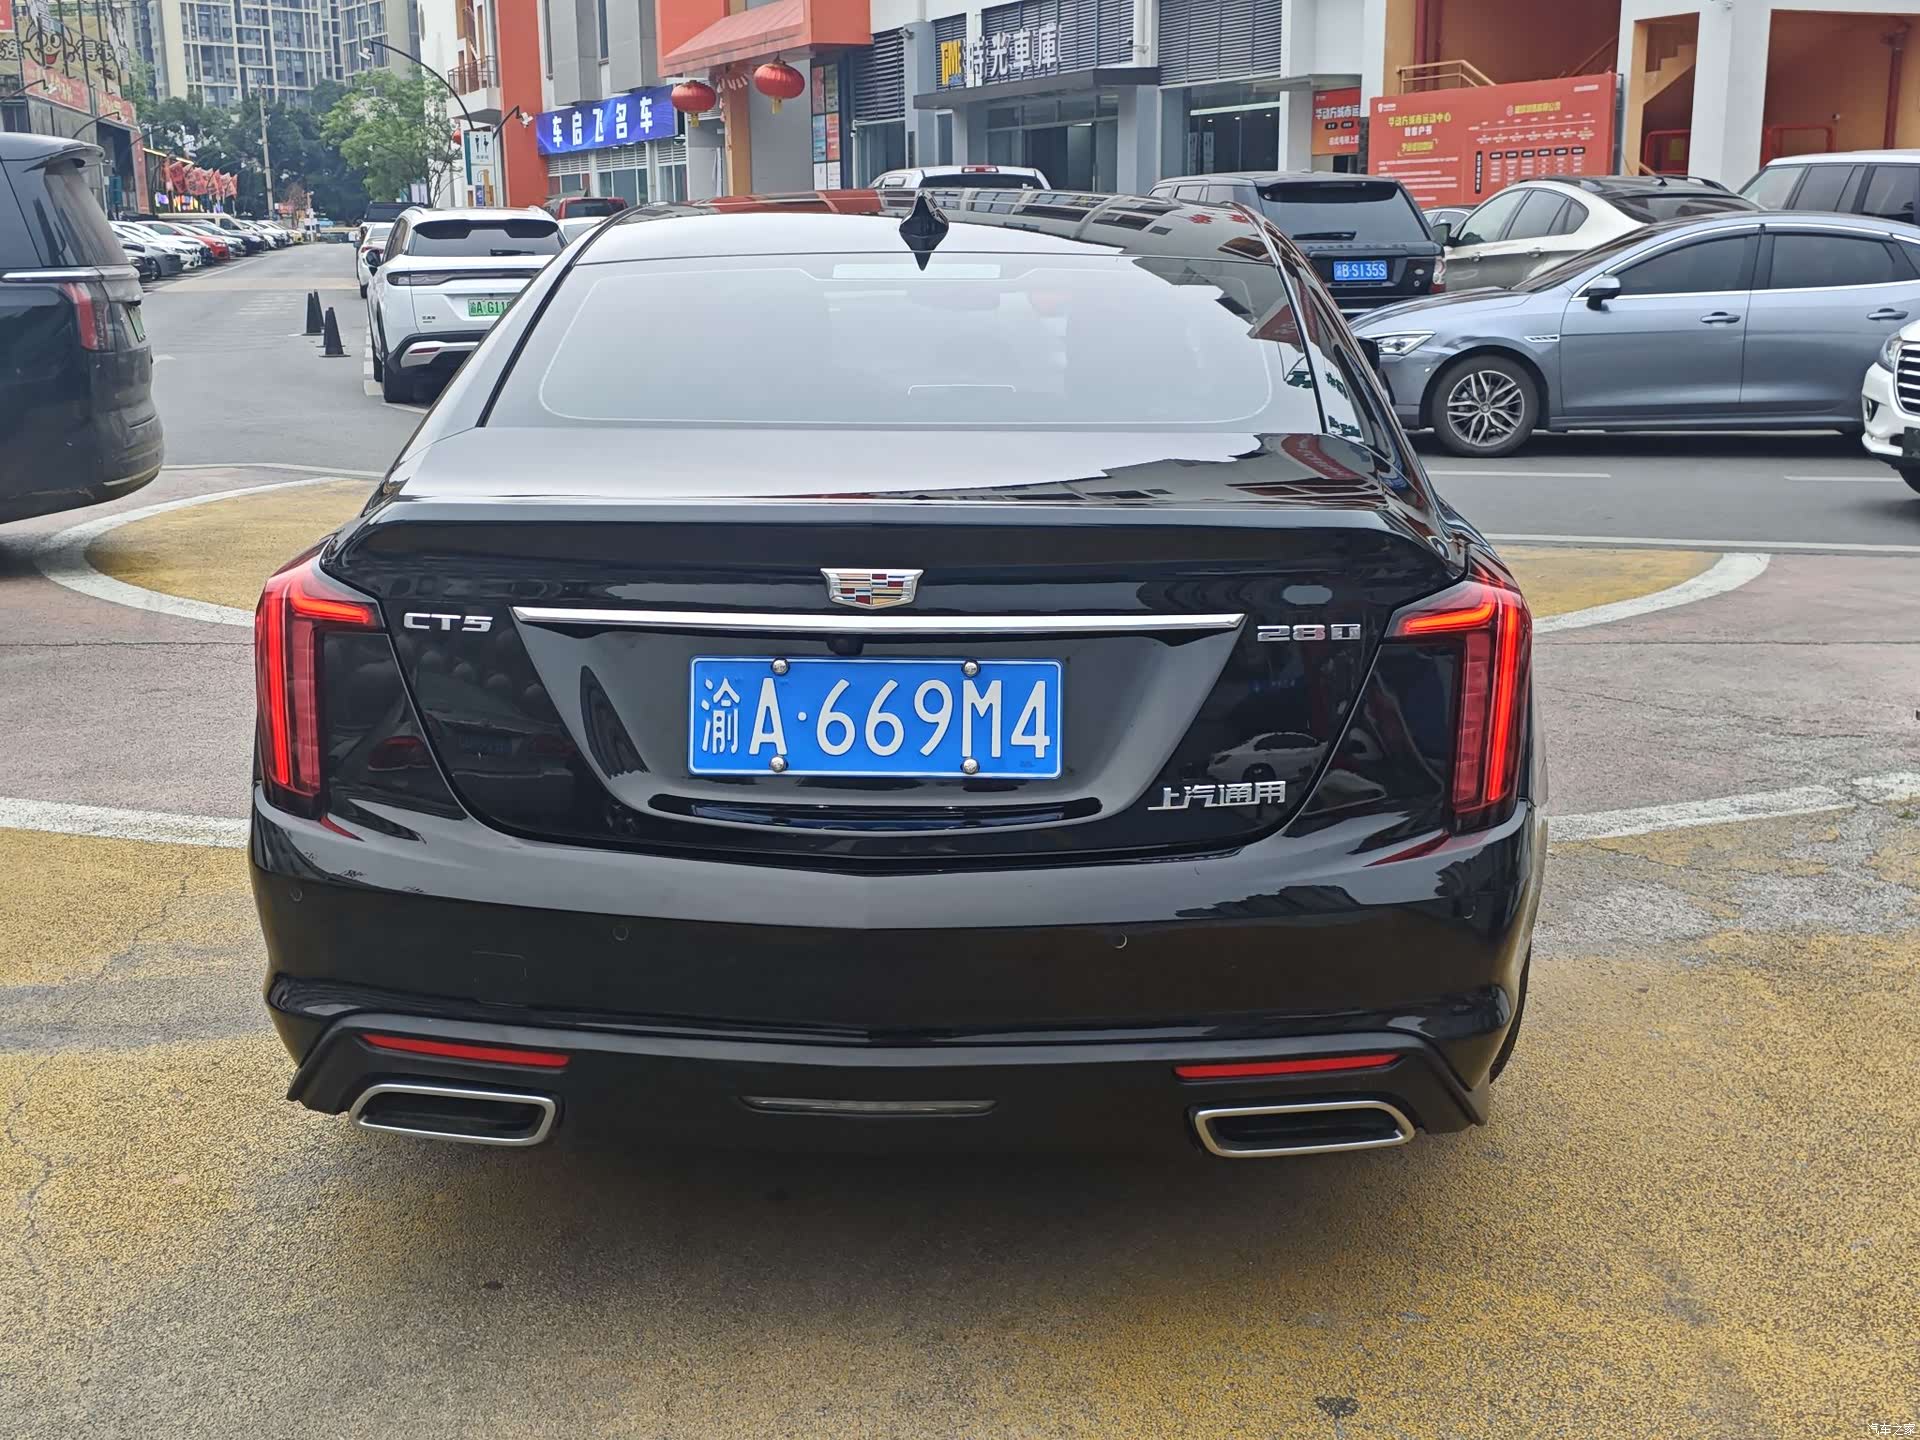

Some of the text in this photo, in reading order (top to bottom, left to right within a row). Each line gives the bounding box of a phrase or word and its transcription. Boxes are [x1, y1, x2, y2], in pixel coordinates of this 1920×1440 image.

[966, 22, 1058, 88] 時光車庫
[552, 96, 653, 148] 车启飞名车
[1147, 780, 1287, 811] 上汽通用
